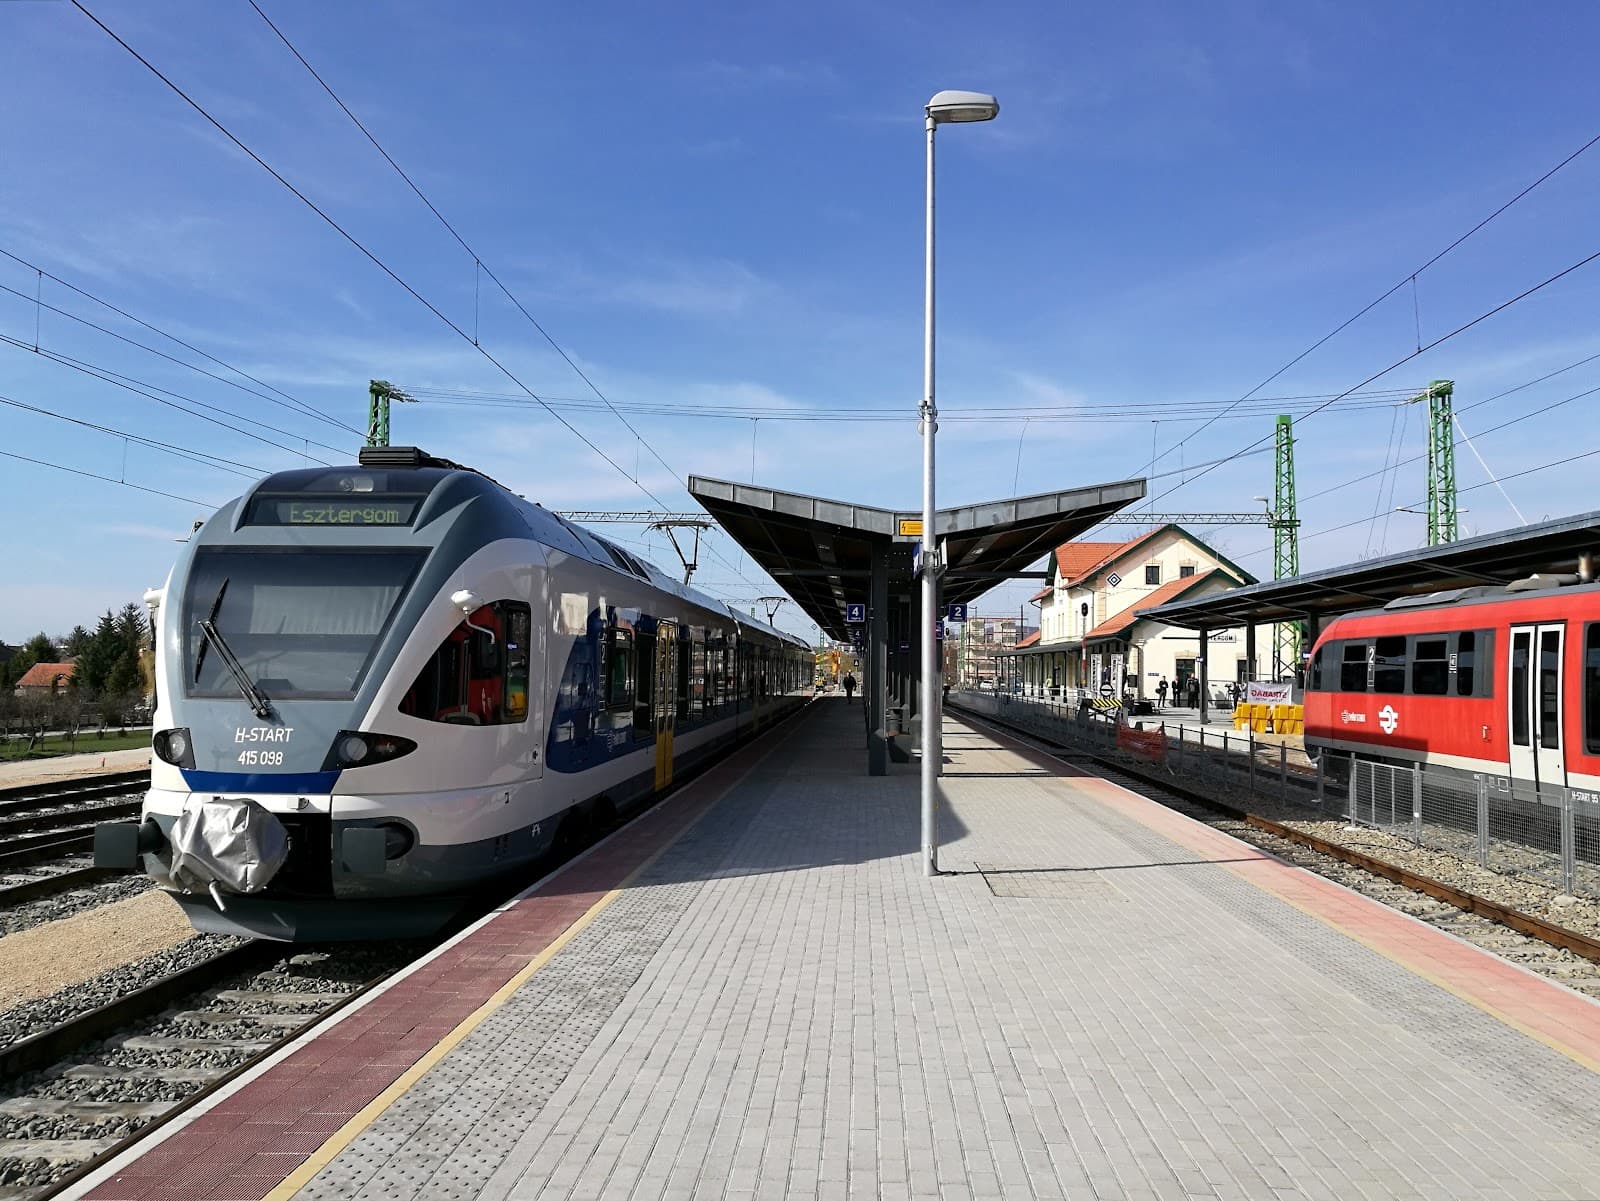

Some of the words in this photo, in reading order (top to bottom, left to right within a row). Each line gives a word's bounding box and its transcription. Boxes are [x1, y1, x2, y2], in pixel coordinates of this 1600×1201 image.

[290, 503, 399, 523] Esztergom
[851, 606, 859, 617] 4
[954, 606, 962, 617] 2
[1368, 647, 1375, 663] 2
[234, 727, 294, 743] H-START
[237, 750, 258, 765] 415
[260, 751, 283, 765] 098
